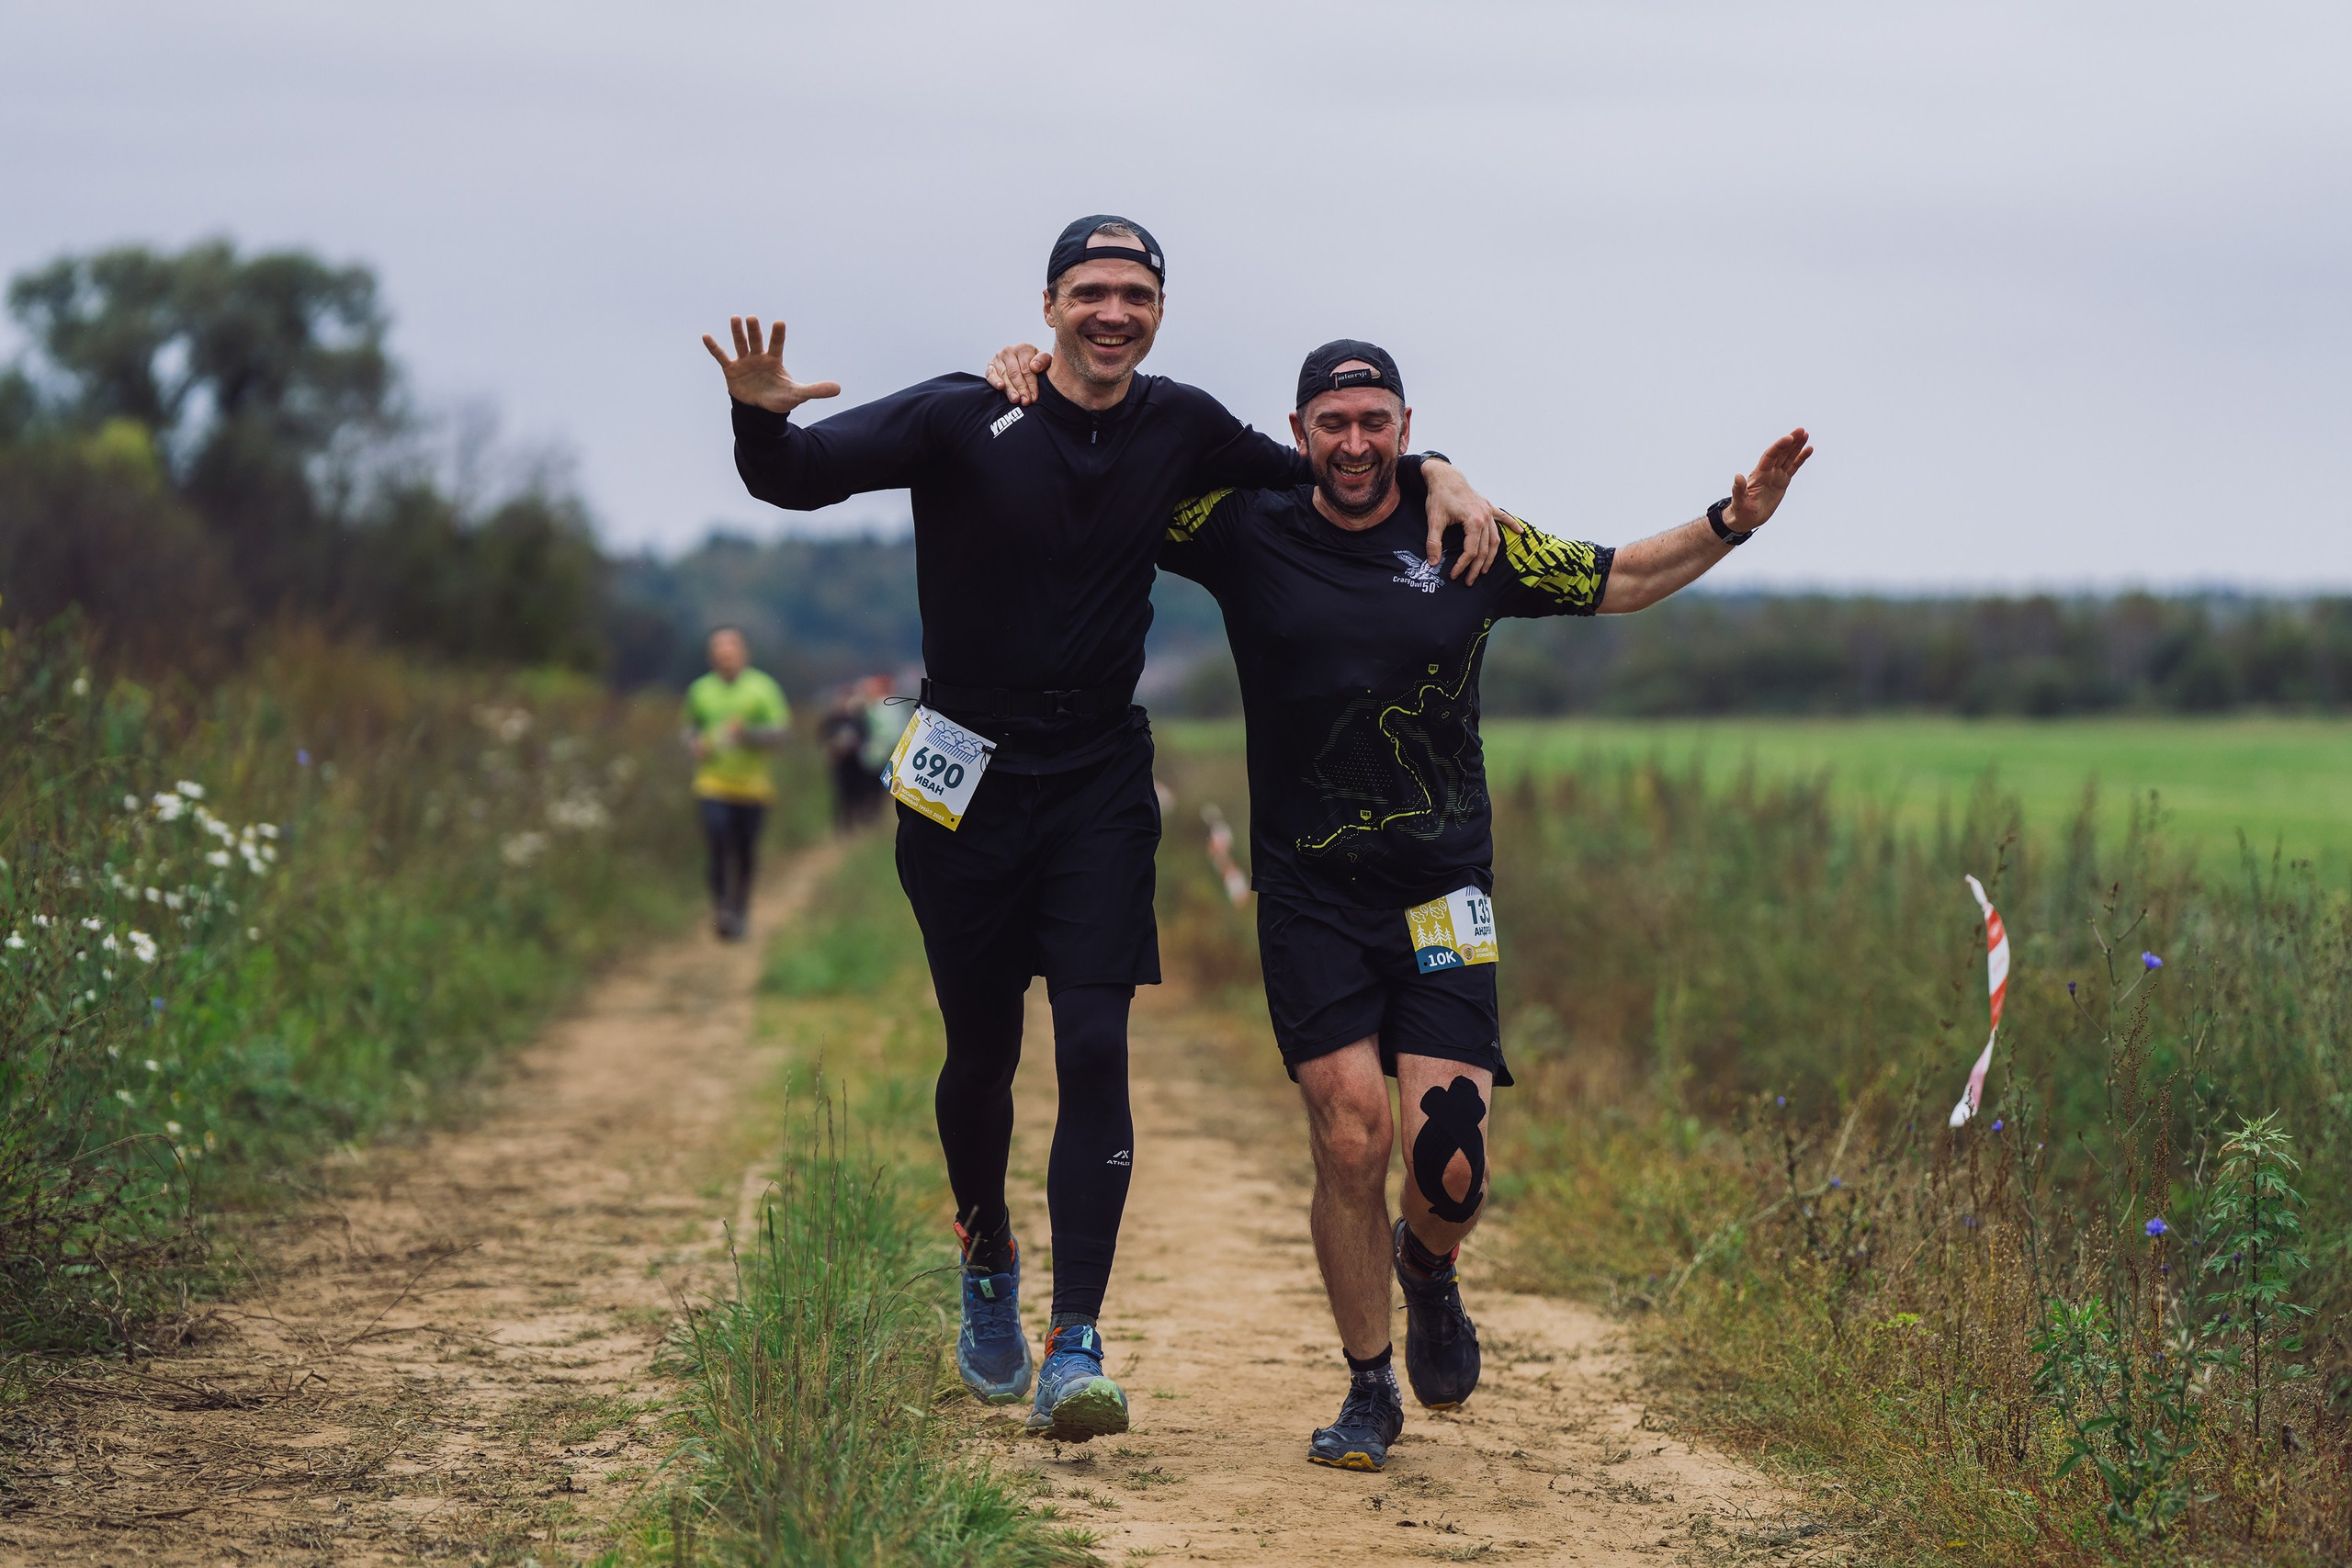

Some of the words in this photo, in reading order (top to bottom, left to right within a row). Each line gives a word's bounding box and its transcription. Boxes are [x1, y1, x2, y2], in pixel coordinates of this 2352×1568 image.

[1338, 371, 1367, 381] alenji
[1421, 581, 1436, 593] 50
[911, 746, 965, 789] 690
[914, 773, 944, 795] ИВАН
[1466, 898, 1490, 925] 135
[1428, 951, 1457, 967] 10K
